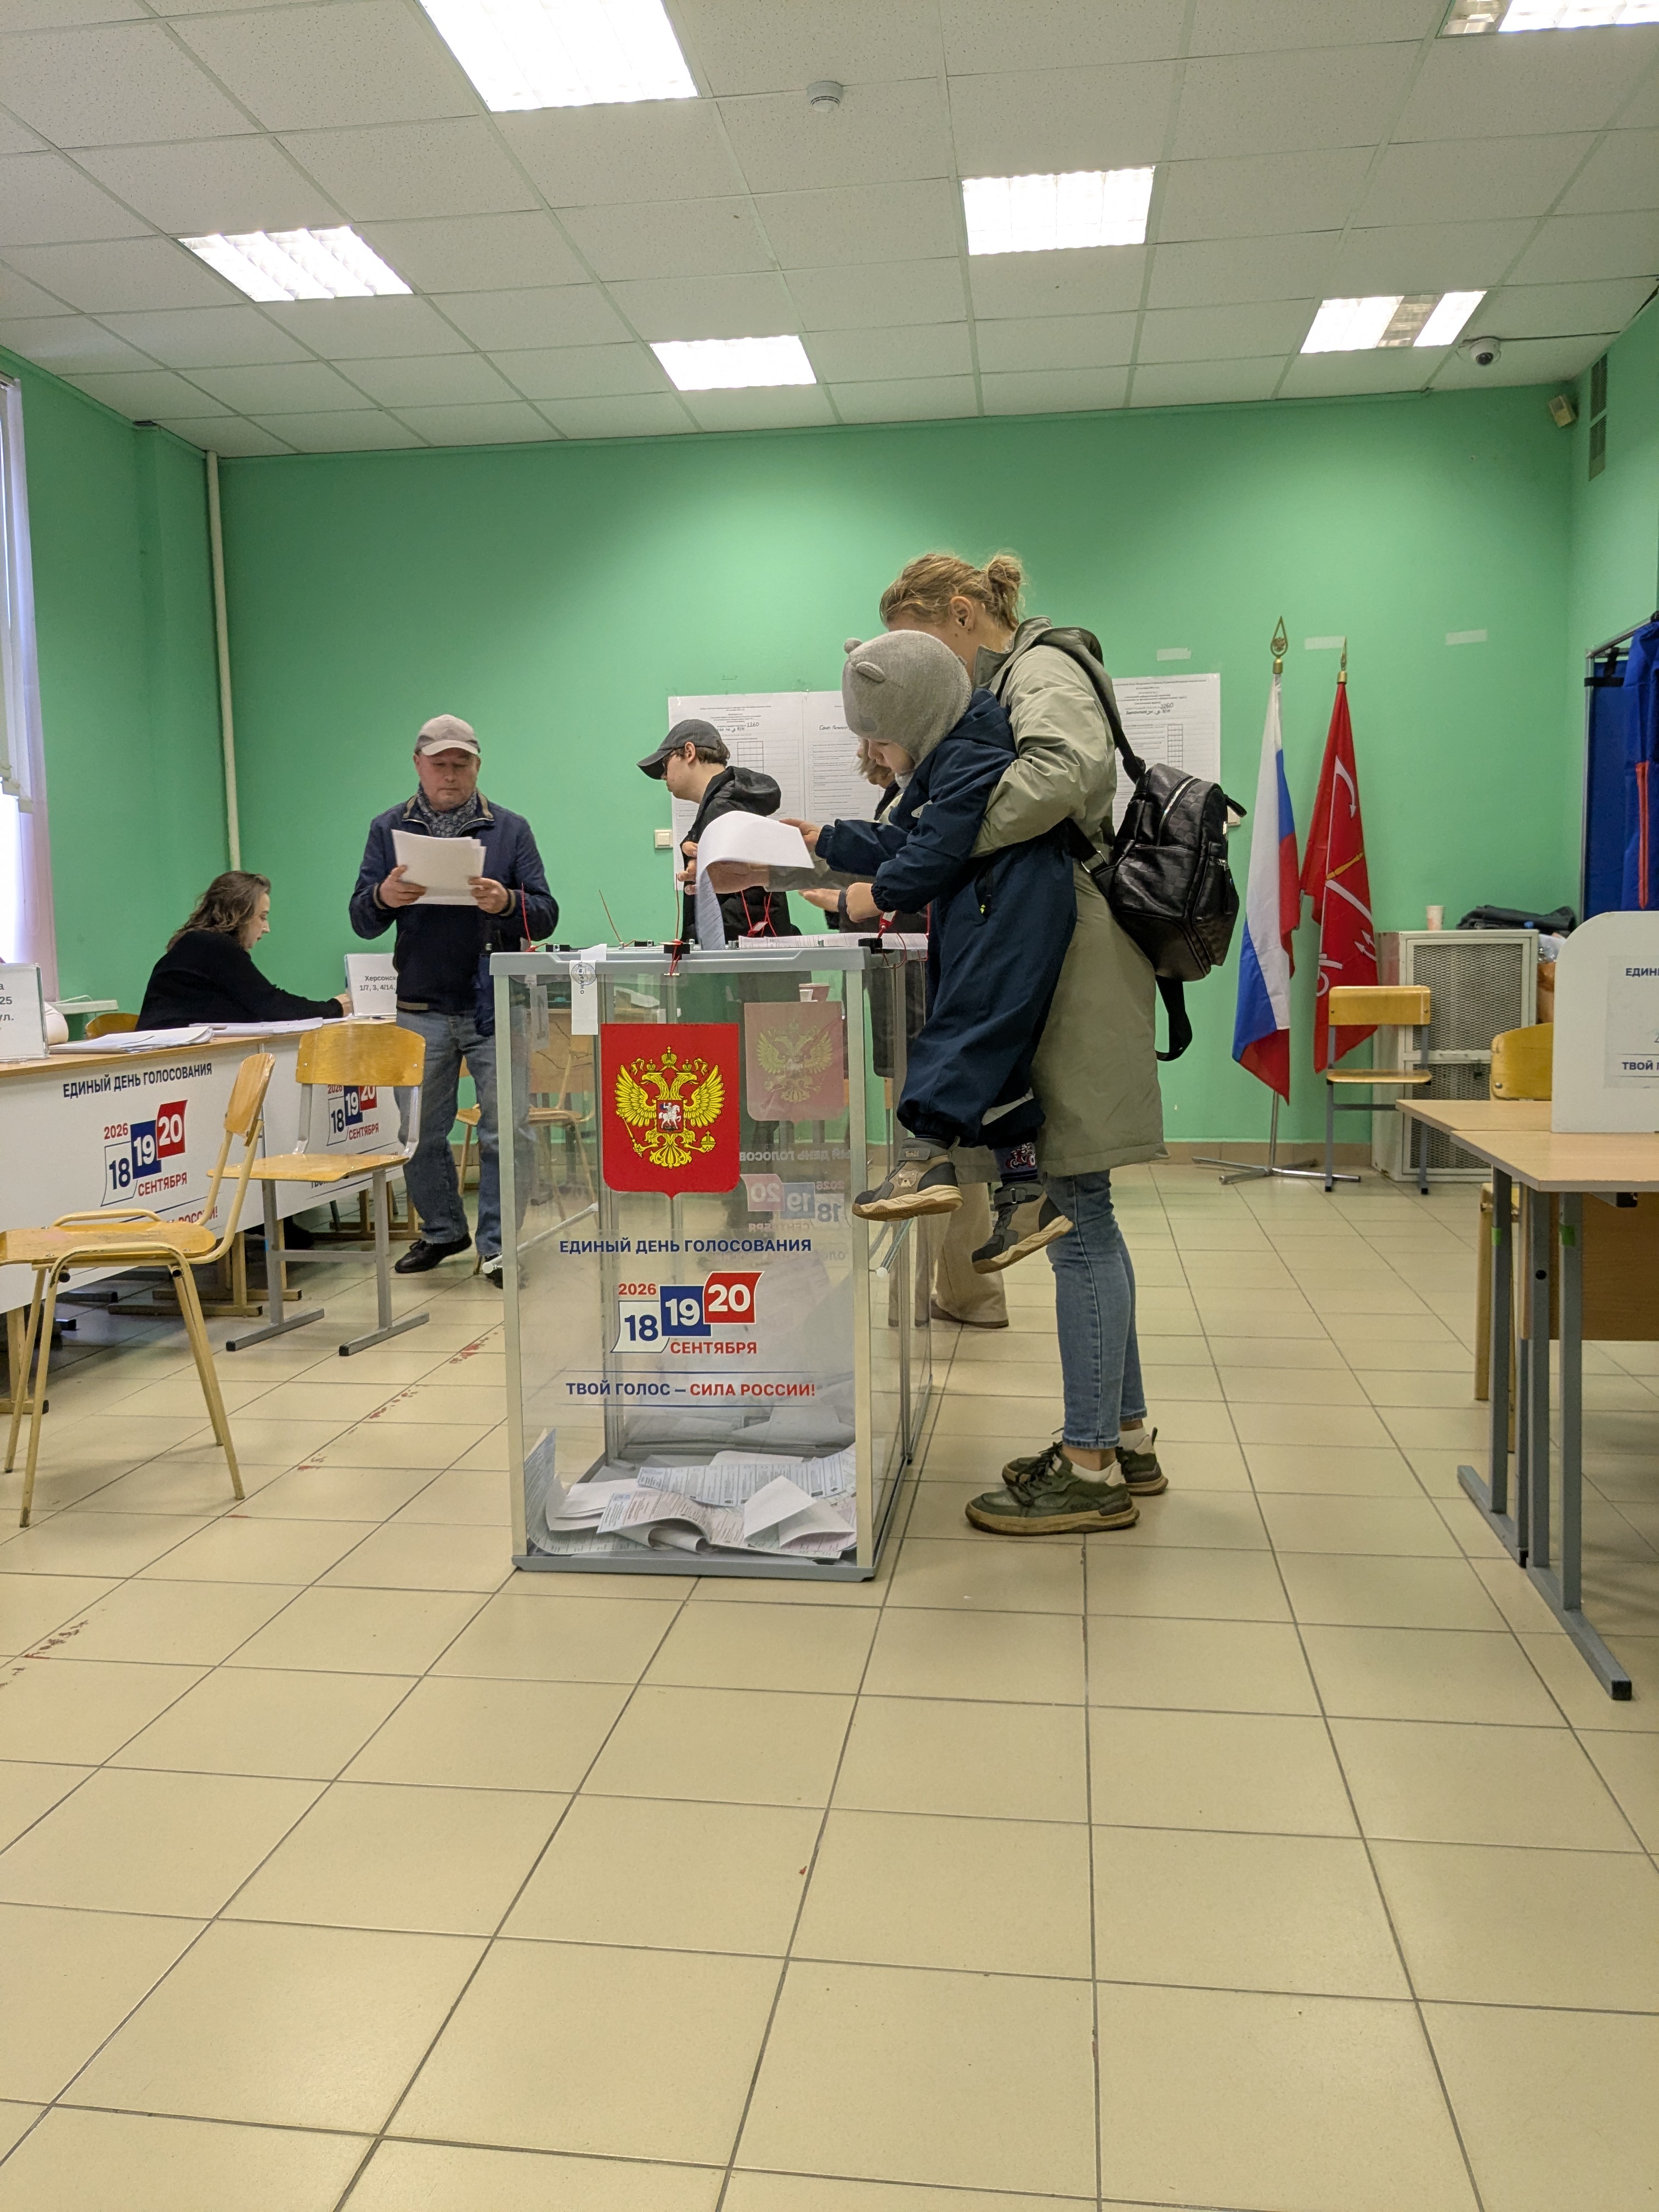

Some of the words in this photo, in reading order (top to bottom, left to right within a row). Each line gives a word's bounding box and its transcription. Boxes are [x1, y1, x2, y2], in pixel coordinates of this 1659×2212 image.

[1626, 968, 1659, 977] ЕДИН
[1622, 1060, 1653, 1070] ТВОЙ
[63, 1074, 111, 1099] ЕДИНЫЙ
[114, 1073, 141, 1092] ДЕНЬ
[143, 1063, 212, 1085] ГОЛОСОВАНИЯ
[331, 1109, 345, 1133] 18
[346, 1092, 359, 1116] 19
[104, 1123, 128, 1140] 2026
[349, 1123, 379, 1140] СЕНТЯБРЯ
[109, 1158, 131, 1190] 18
[134, 1135, 155, 1167] 19
[158, 1114, 183, 1146] 20
[138, 1172, 187, 1197] СЕНТЯБРЯ
[560, 1237, 631, 1255] ЕДИНЫЙ
[636, 1239, 680, 1255] ДЕНЬ
[685, 1239, 812, 1252] ГОЛОСОВАНИЯ
[618, 1283, 657, 1295] 2026
[624, 1314, 658, 1341] 18
[665, 1298, 700, 1326] 19
[708, 1284, 751, 1312] 20
[670, 1342, 757, 1354] СЕНТЯБРЯ
[566, 1380, 611, 1396] ТВОЙ
[616, 1383, 670, 1396] ГОЛОС
[690, 1384, 735, 1396] СИЛА
[741, 1384, 815, 1396] РОССИИ!
